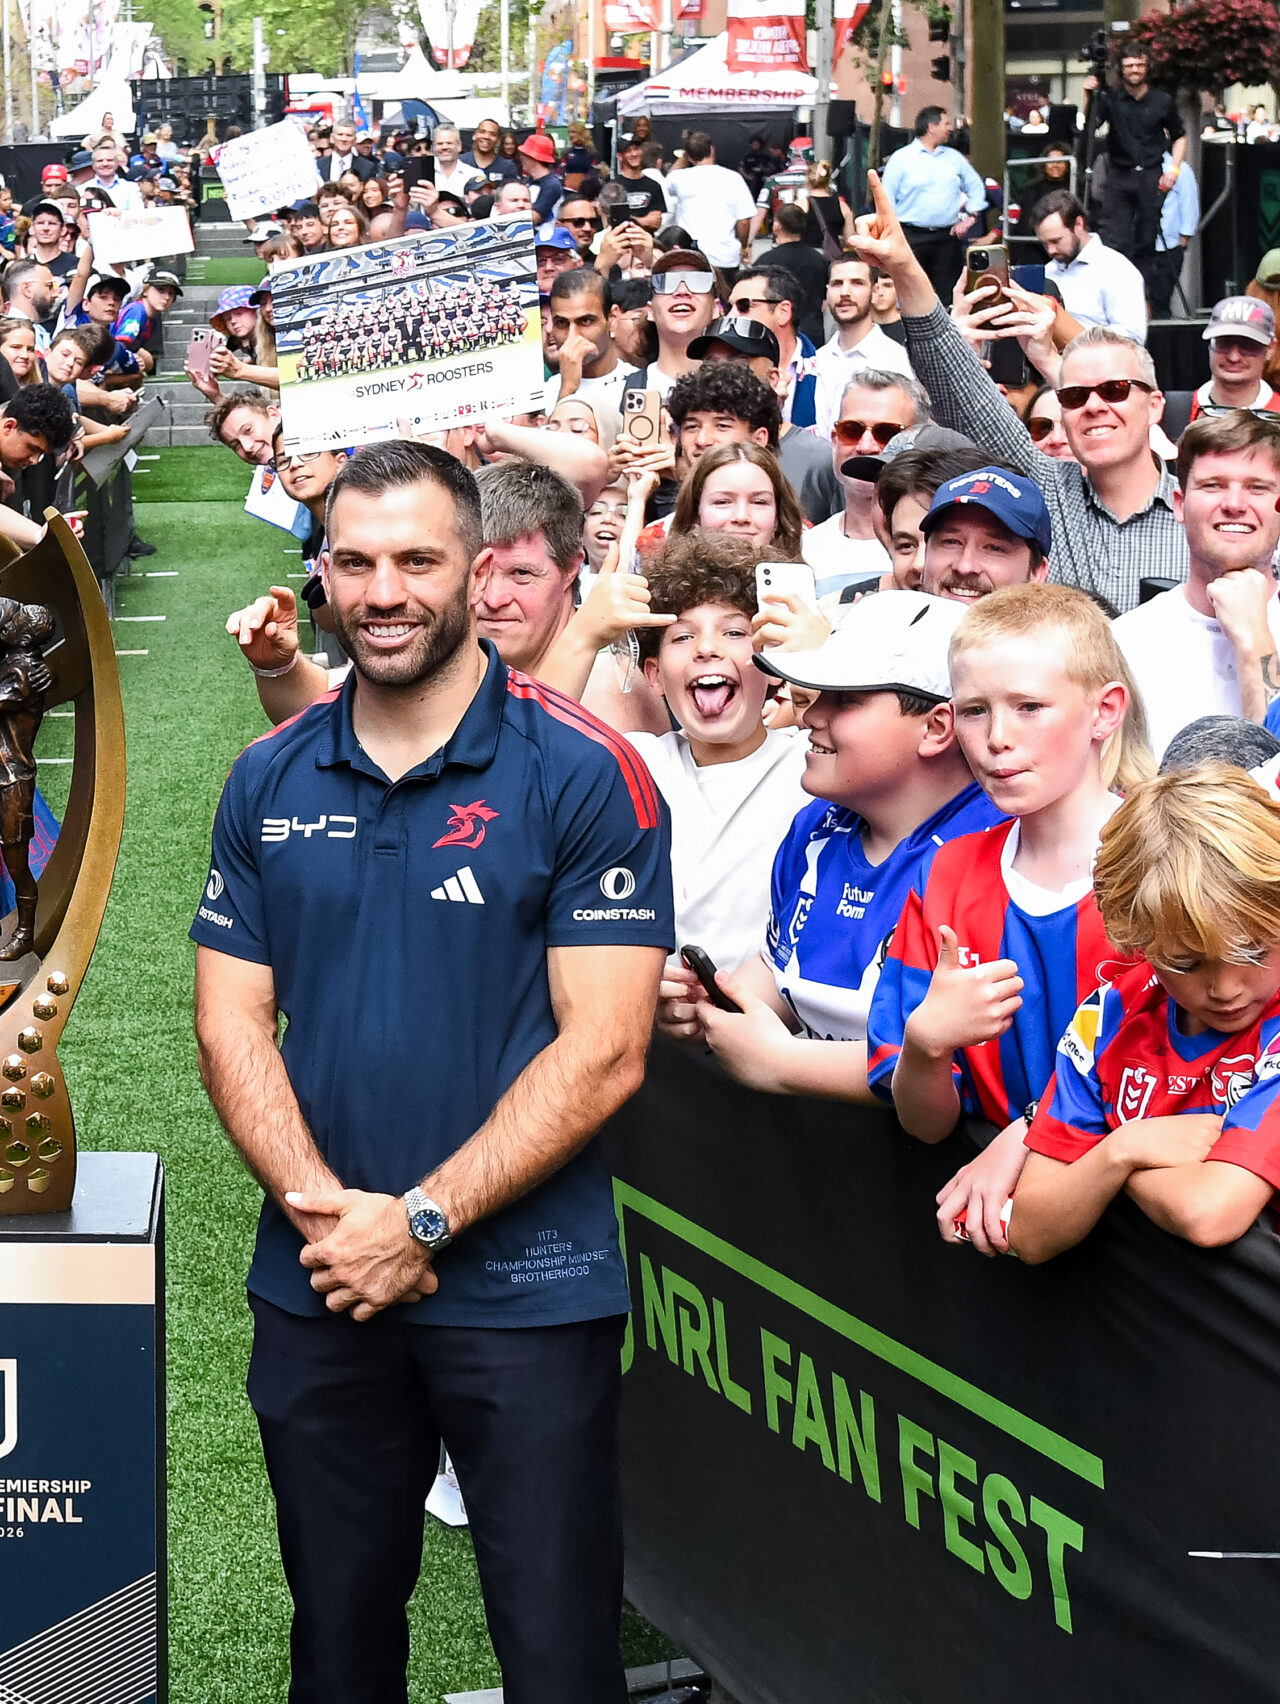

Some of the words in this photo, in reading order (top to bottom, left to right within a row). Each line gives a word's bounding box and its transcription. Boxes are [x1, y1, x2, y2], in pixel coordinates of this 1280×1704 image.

[679, 86, 806, 102] MEMBERSHIP
[355, 379, 406, 398] SYDNEY
[426, 361, 494, 385] ROOSTERS
[948, 472, 1022, 499] ROOSTERS
[260, 815, 358, 842] BYD
[572, 909, 656, 921] COINSTASH
[536, 1229, 559, 1241] 1173
[525, 1241, 573, 1257] HUNTERS
[485, 1255, 567, 1271] CHAMPIONSHIP
[568, 1249, 610, 1265] MINDSET
[510, 1266, 590, 1284] BROTHERHOOD
[639, 1252, 752, 1414] NRL
[760, 1326, 882, 1503] FAN
[896, 1413, 1084, 1635] FEST
